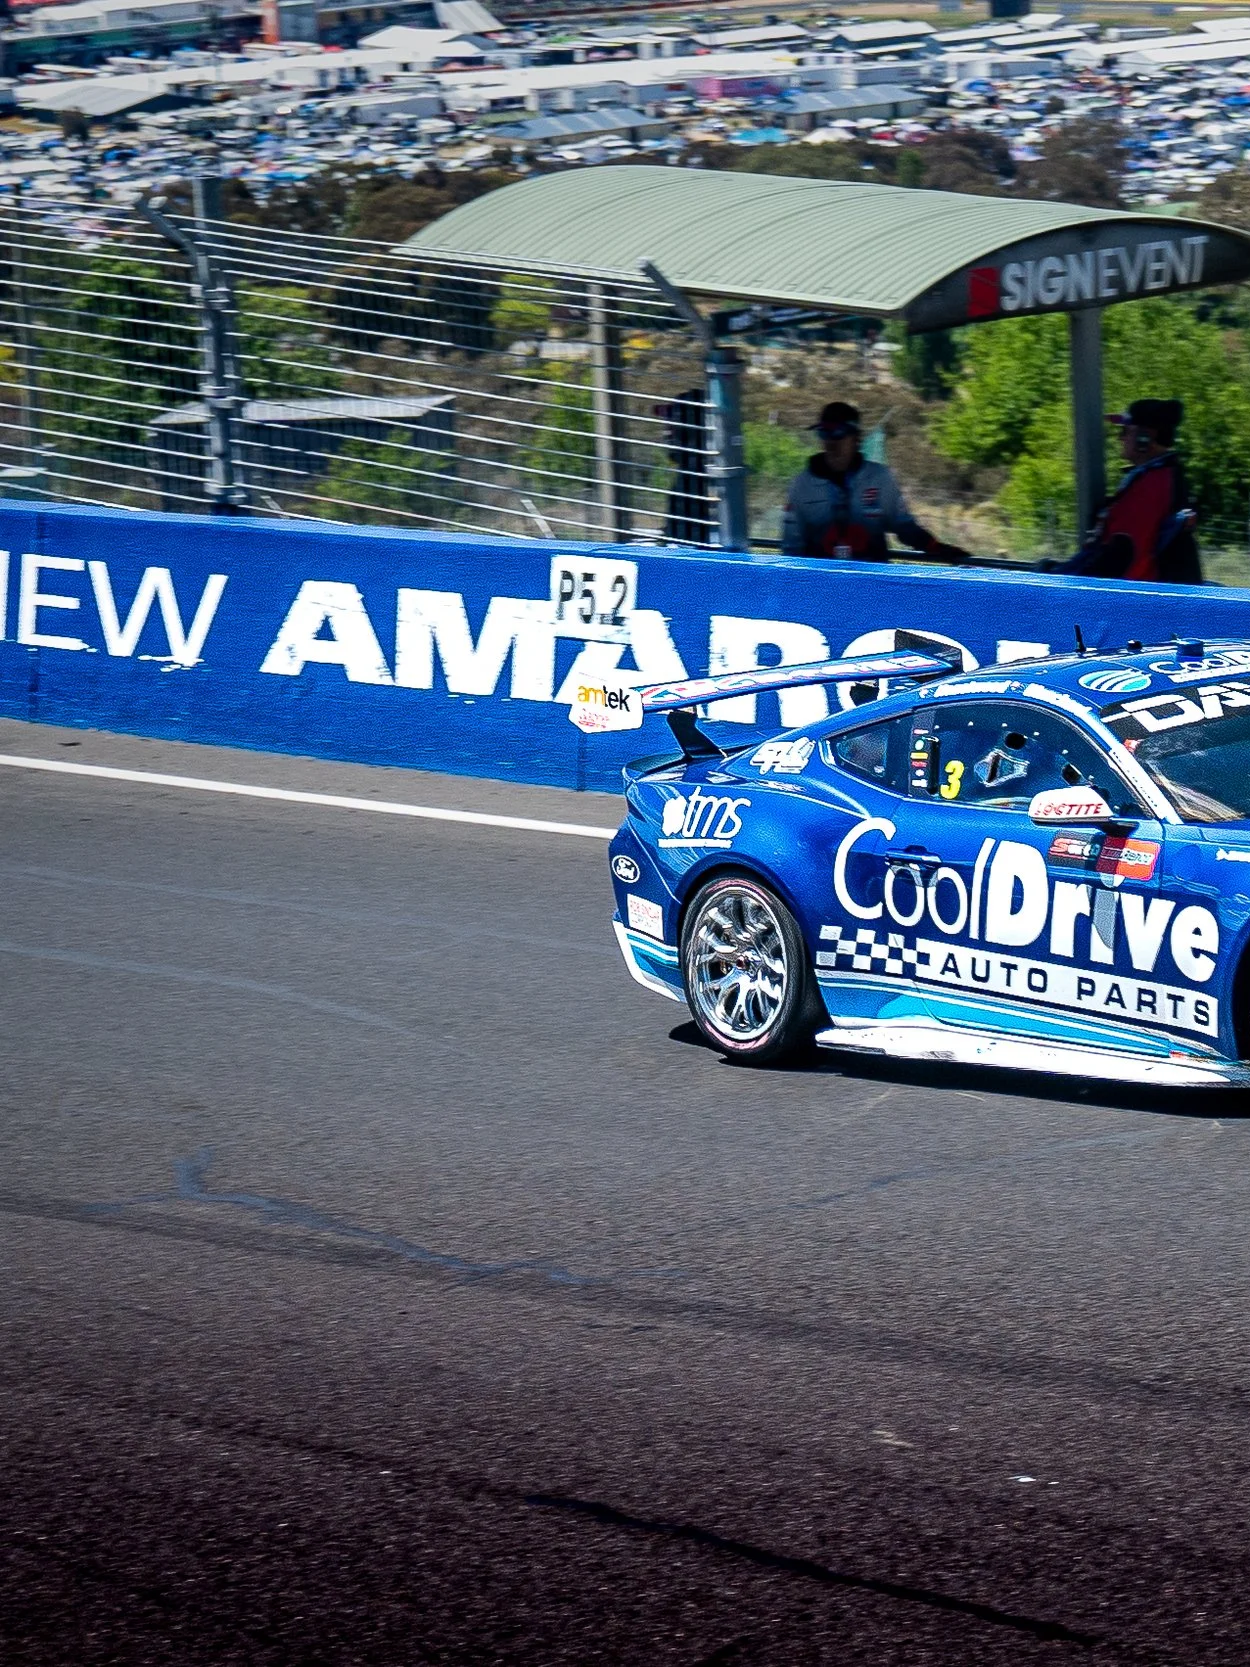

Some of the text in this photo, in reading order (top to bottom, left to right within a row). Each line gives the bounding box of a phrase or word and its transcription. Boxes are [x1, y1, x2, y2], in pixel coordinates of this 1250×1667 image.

[0, 547, 229, 668] EW
[577, 684, 631, 713] amtek
[939, 760, 966, 800] 3
[939, 952, 1212, 1028] AUTO PARTS
